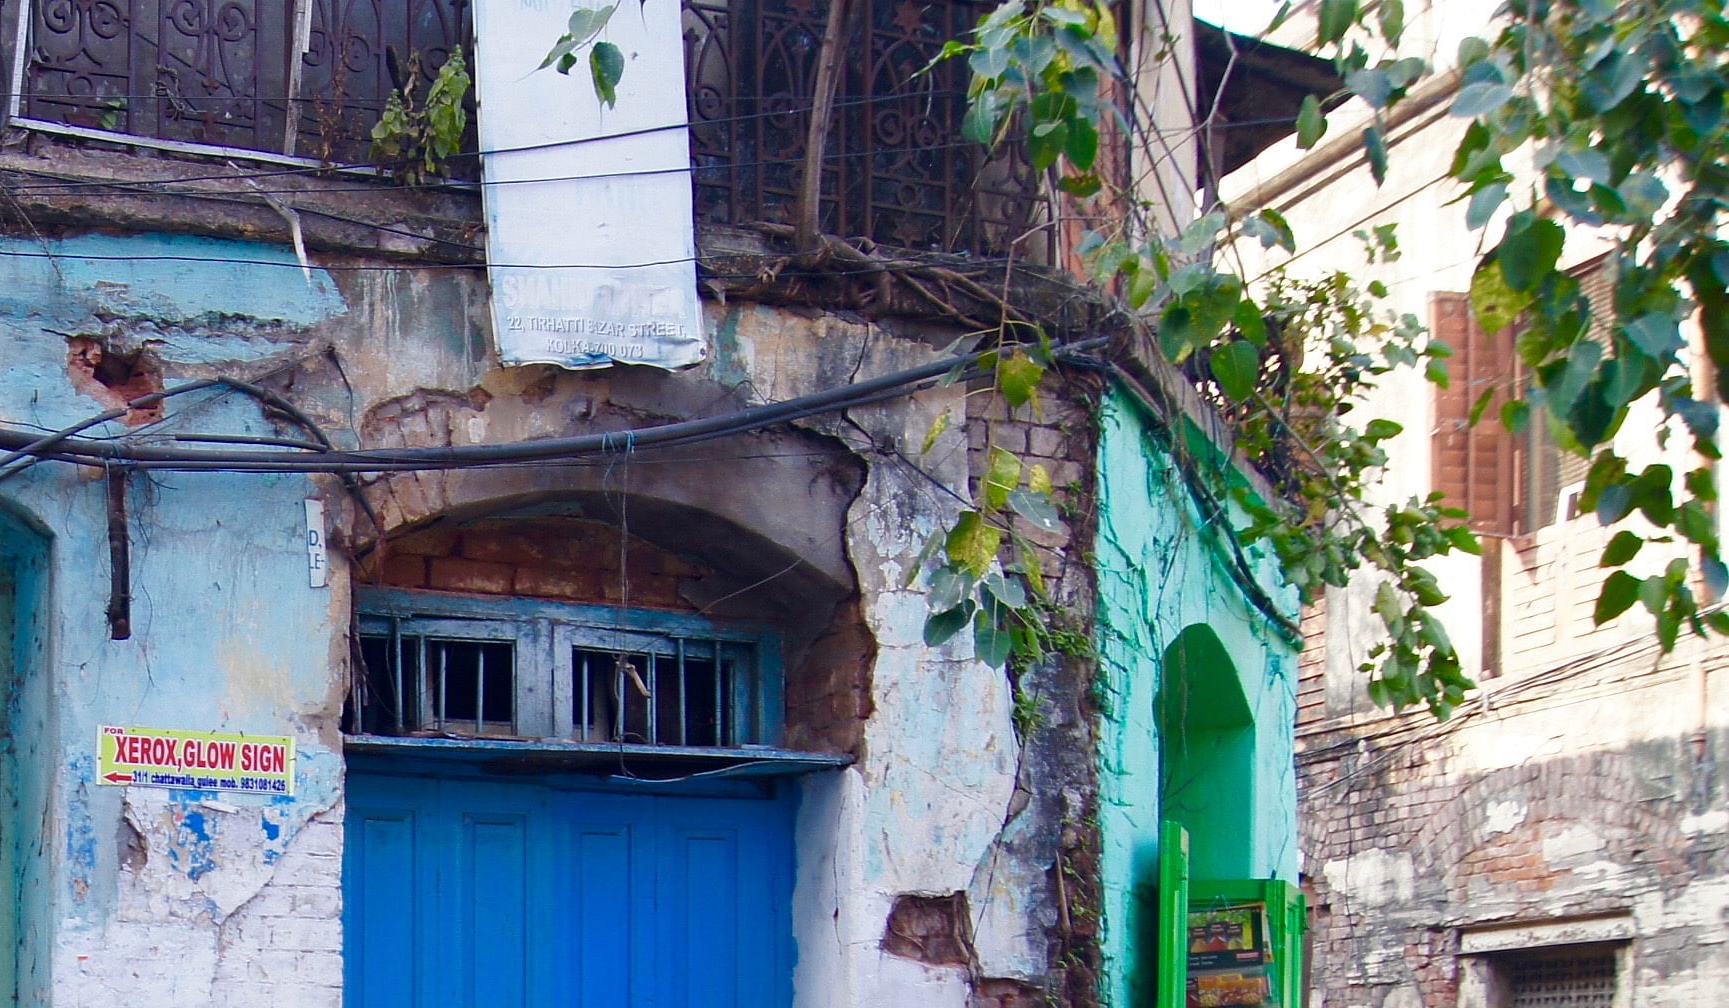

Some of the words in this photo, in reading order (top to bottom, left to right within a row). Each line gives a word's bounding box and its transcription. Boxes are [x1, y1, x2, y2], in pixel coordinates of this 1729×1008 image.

[507, 315, 525, 333] 22,
[527, 316, 585, 334] TIRHATTI
[104, 727, 124, 735] FOR
[241, 743, 286, 773] SIGN
[133, 770, 148, 783] 31/1
